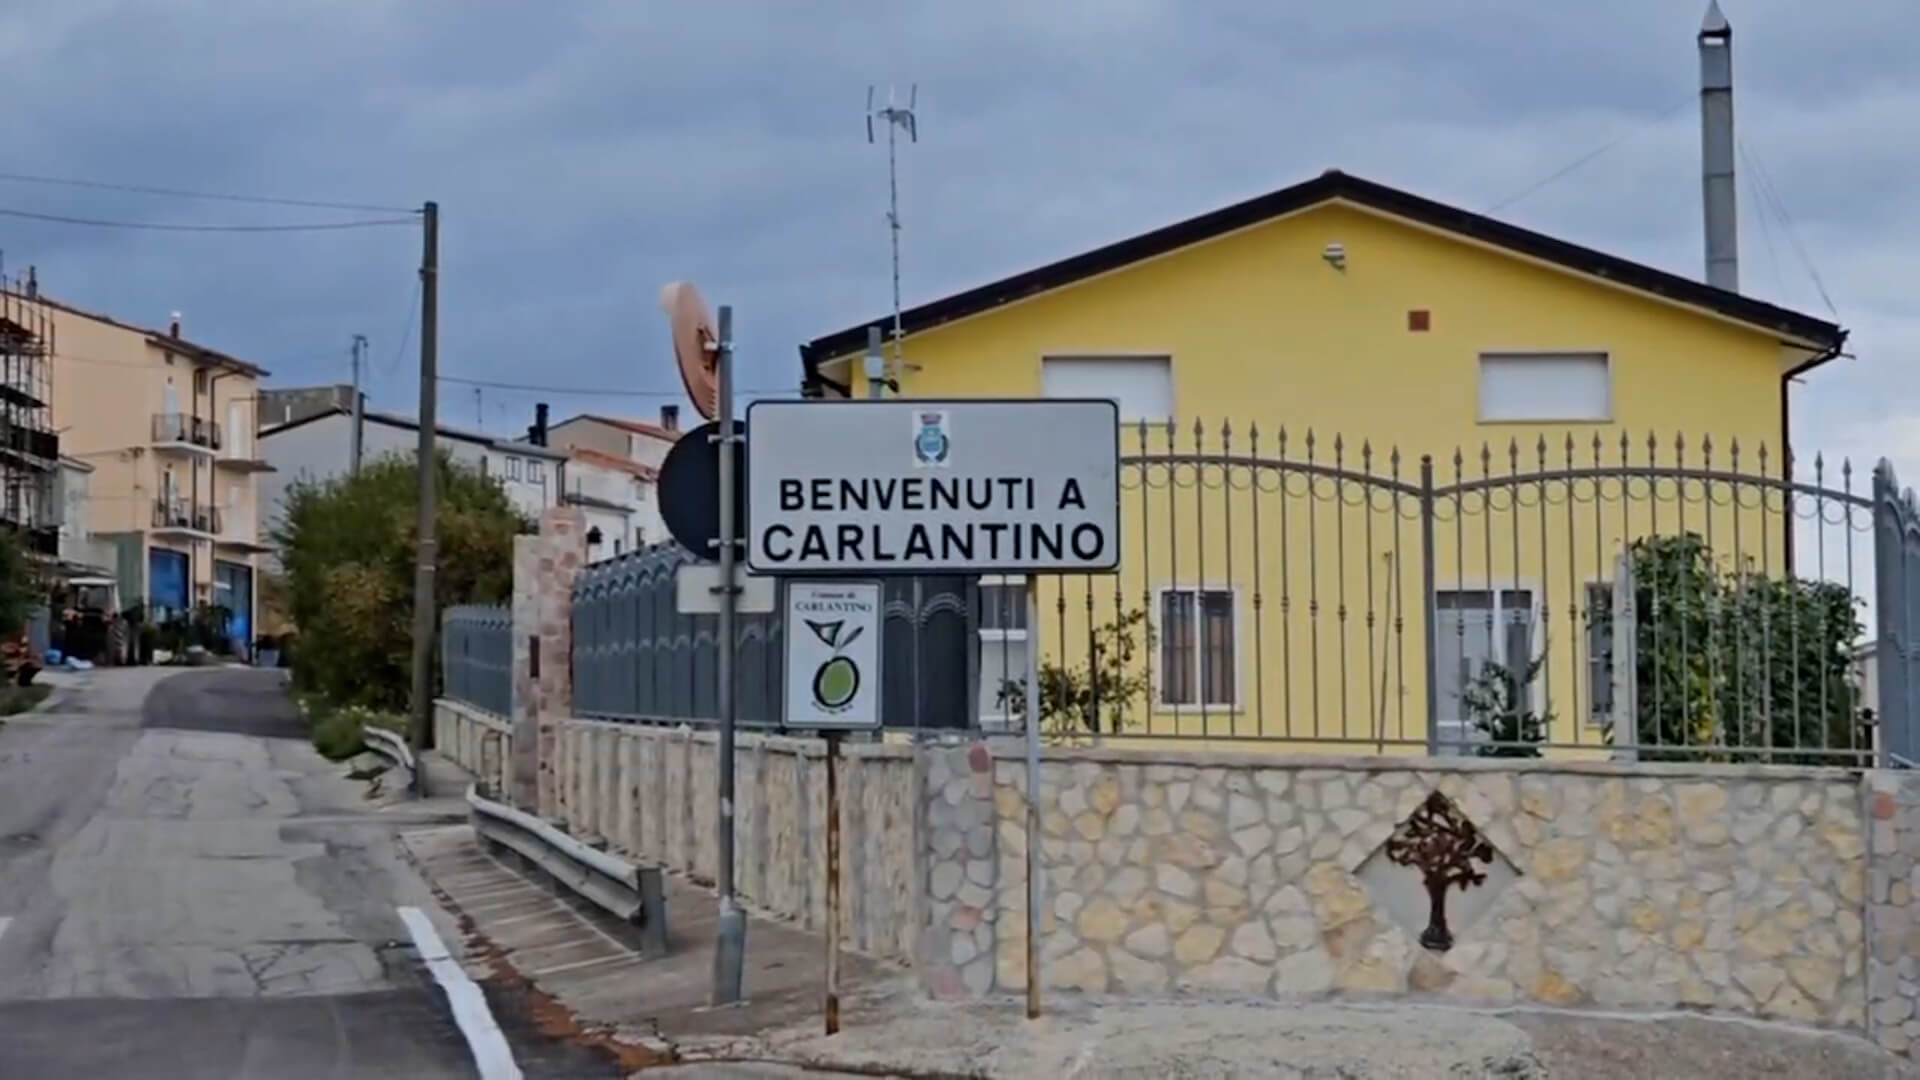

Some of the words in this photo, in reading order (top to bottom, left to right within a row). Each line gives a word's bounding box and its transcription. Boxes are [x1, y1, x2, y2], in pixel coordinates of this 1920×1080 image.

[779, 477, 1035, 512] BENVENUTI
[1057, 477, 1086, 510] A
[762, 522, 1106, 563] CARLANTINO
[794, 601, 873, 613] CARLANTINO
